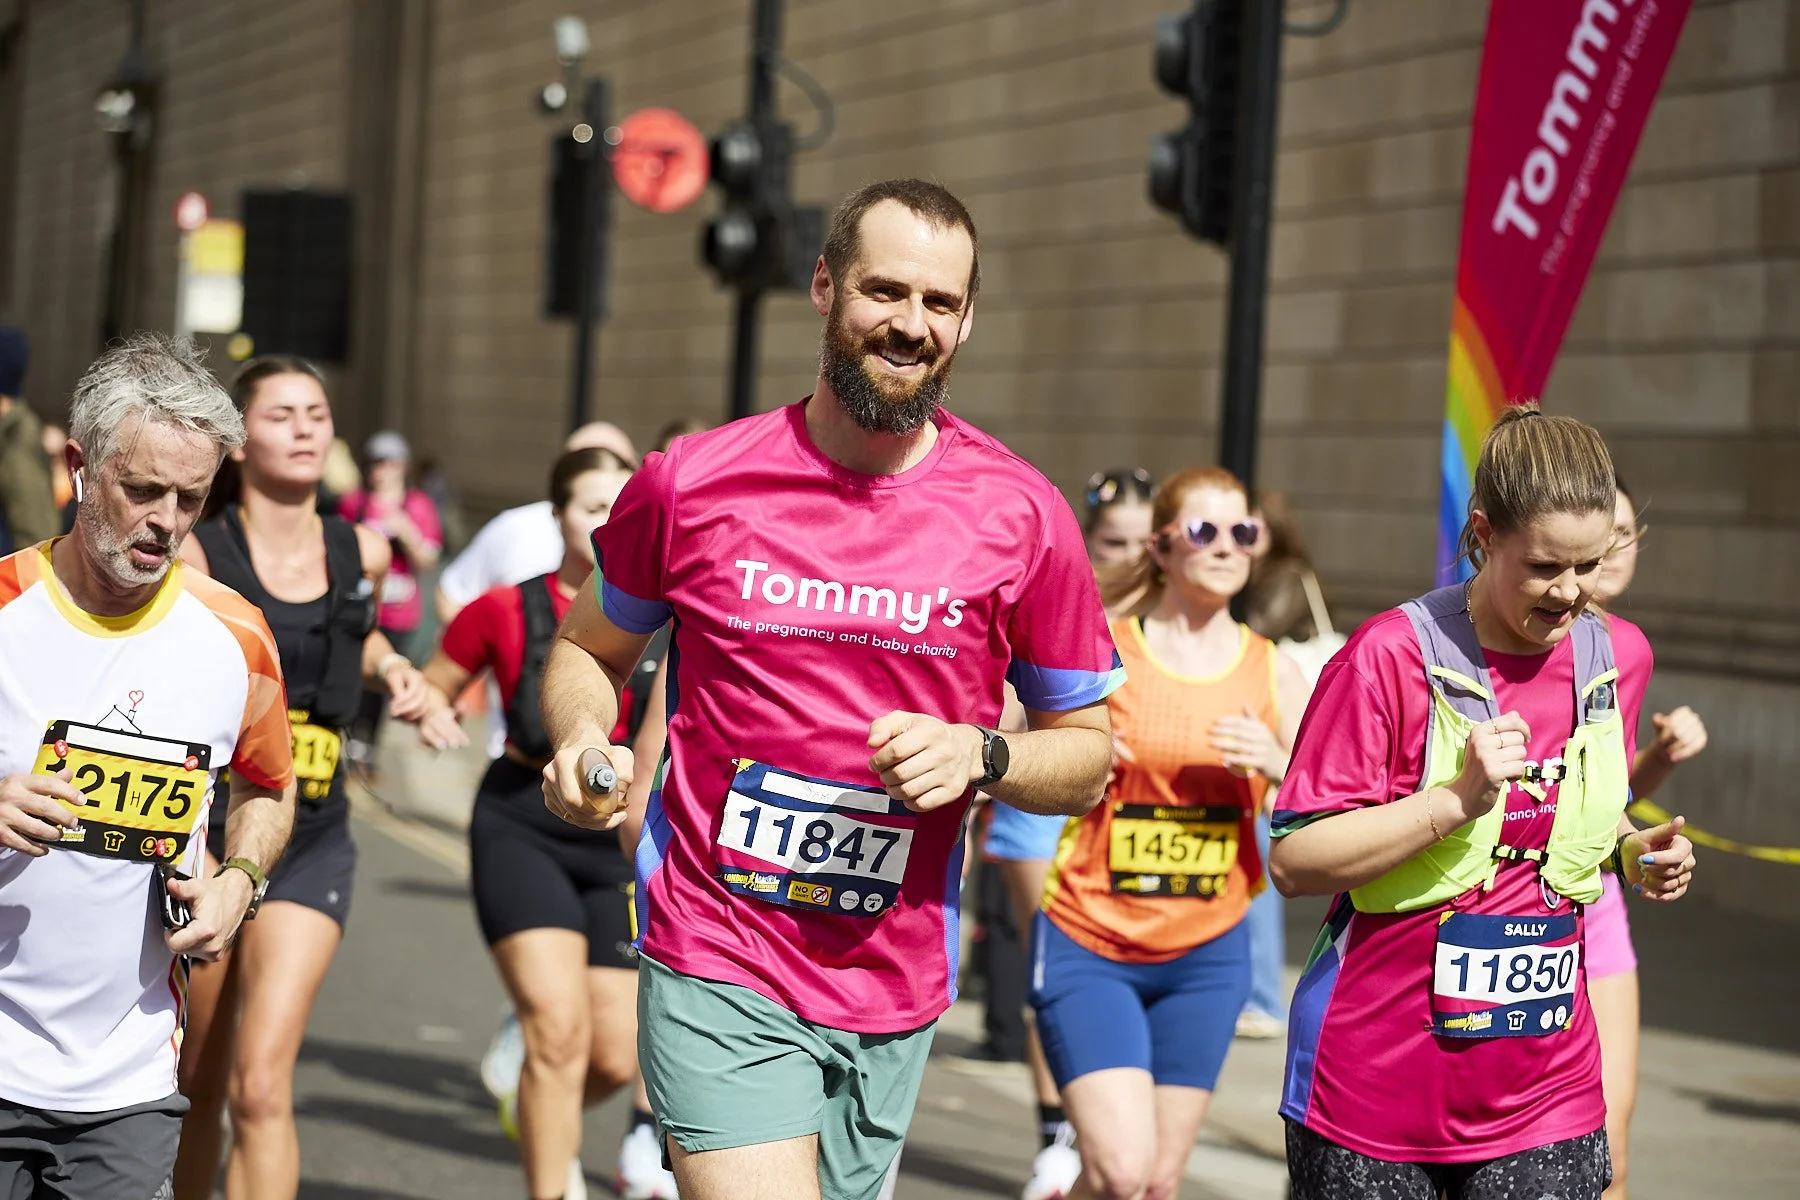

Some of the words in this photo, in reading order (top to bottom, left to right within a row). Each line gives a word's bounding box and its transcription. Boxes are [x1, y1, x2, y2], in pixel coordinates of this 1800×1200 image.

[1491, 0, 1636, 240] Tomm
[734, 559, 968, 634] Tommy's
[726, 615, 751, 630] The
[755, 620, 835, 642] pregnancy
[839, 632, 868, 644] and
[871, 634, 910, 654] baby
[913, 642, 958, 659] charity
[739, 805, 901, 874] 11847
[1123, 831, 1228, 863] 14571
[794, 885, 809, 893] NO
[1504, 923, 1548, 937] SALLY
[1450, 949, 1574, 993] 11850
